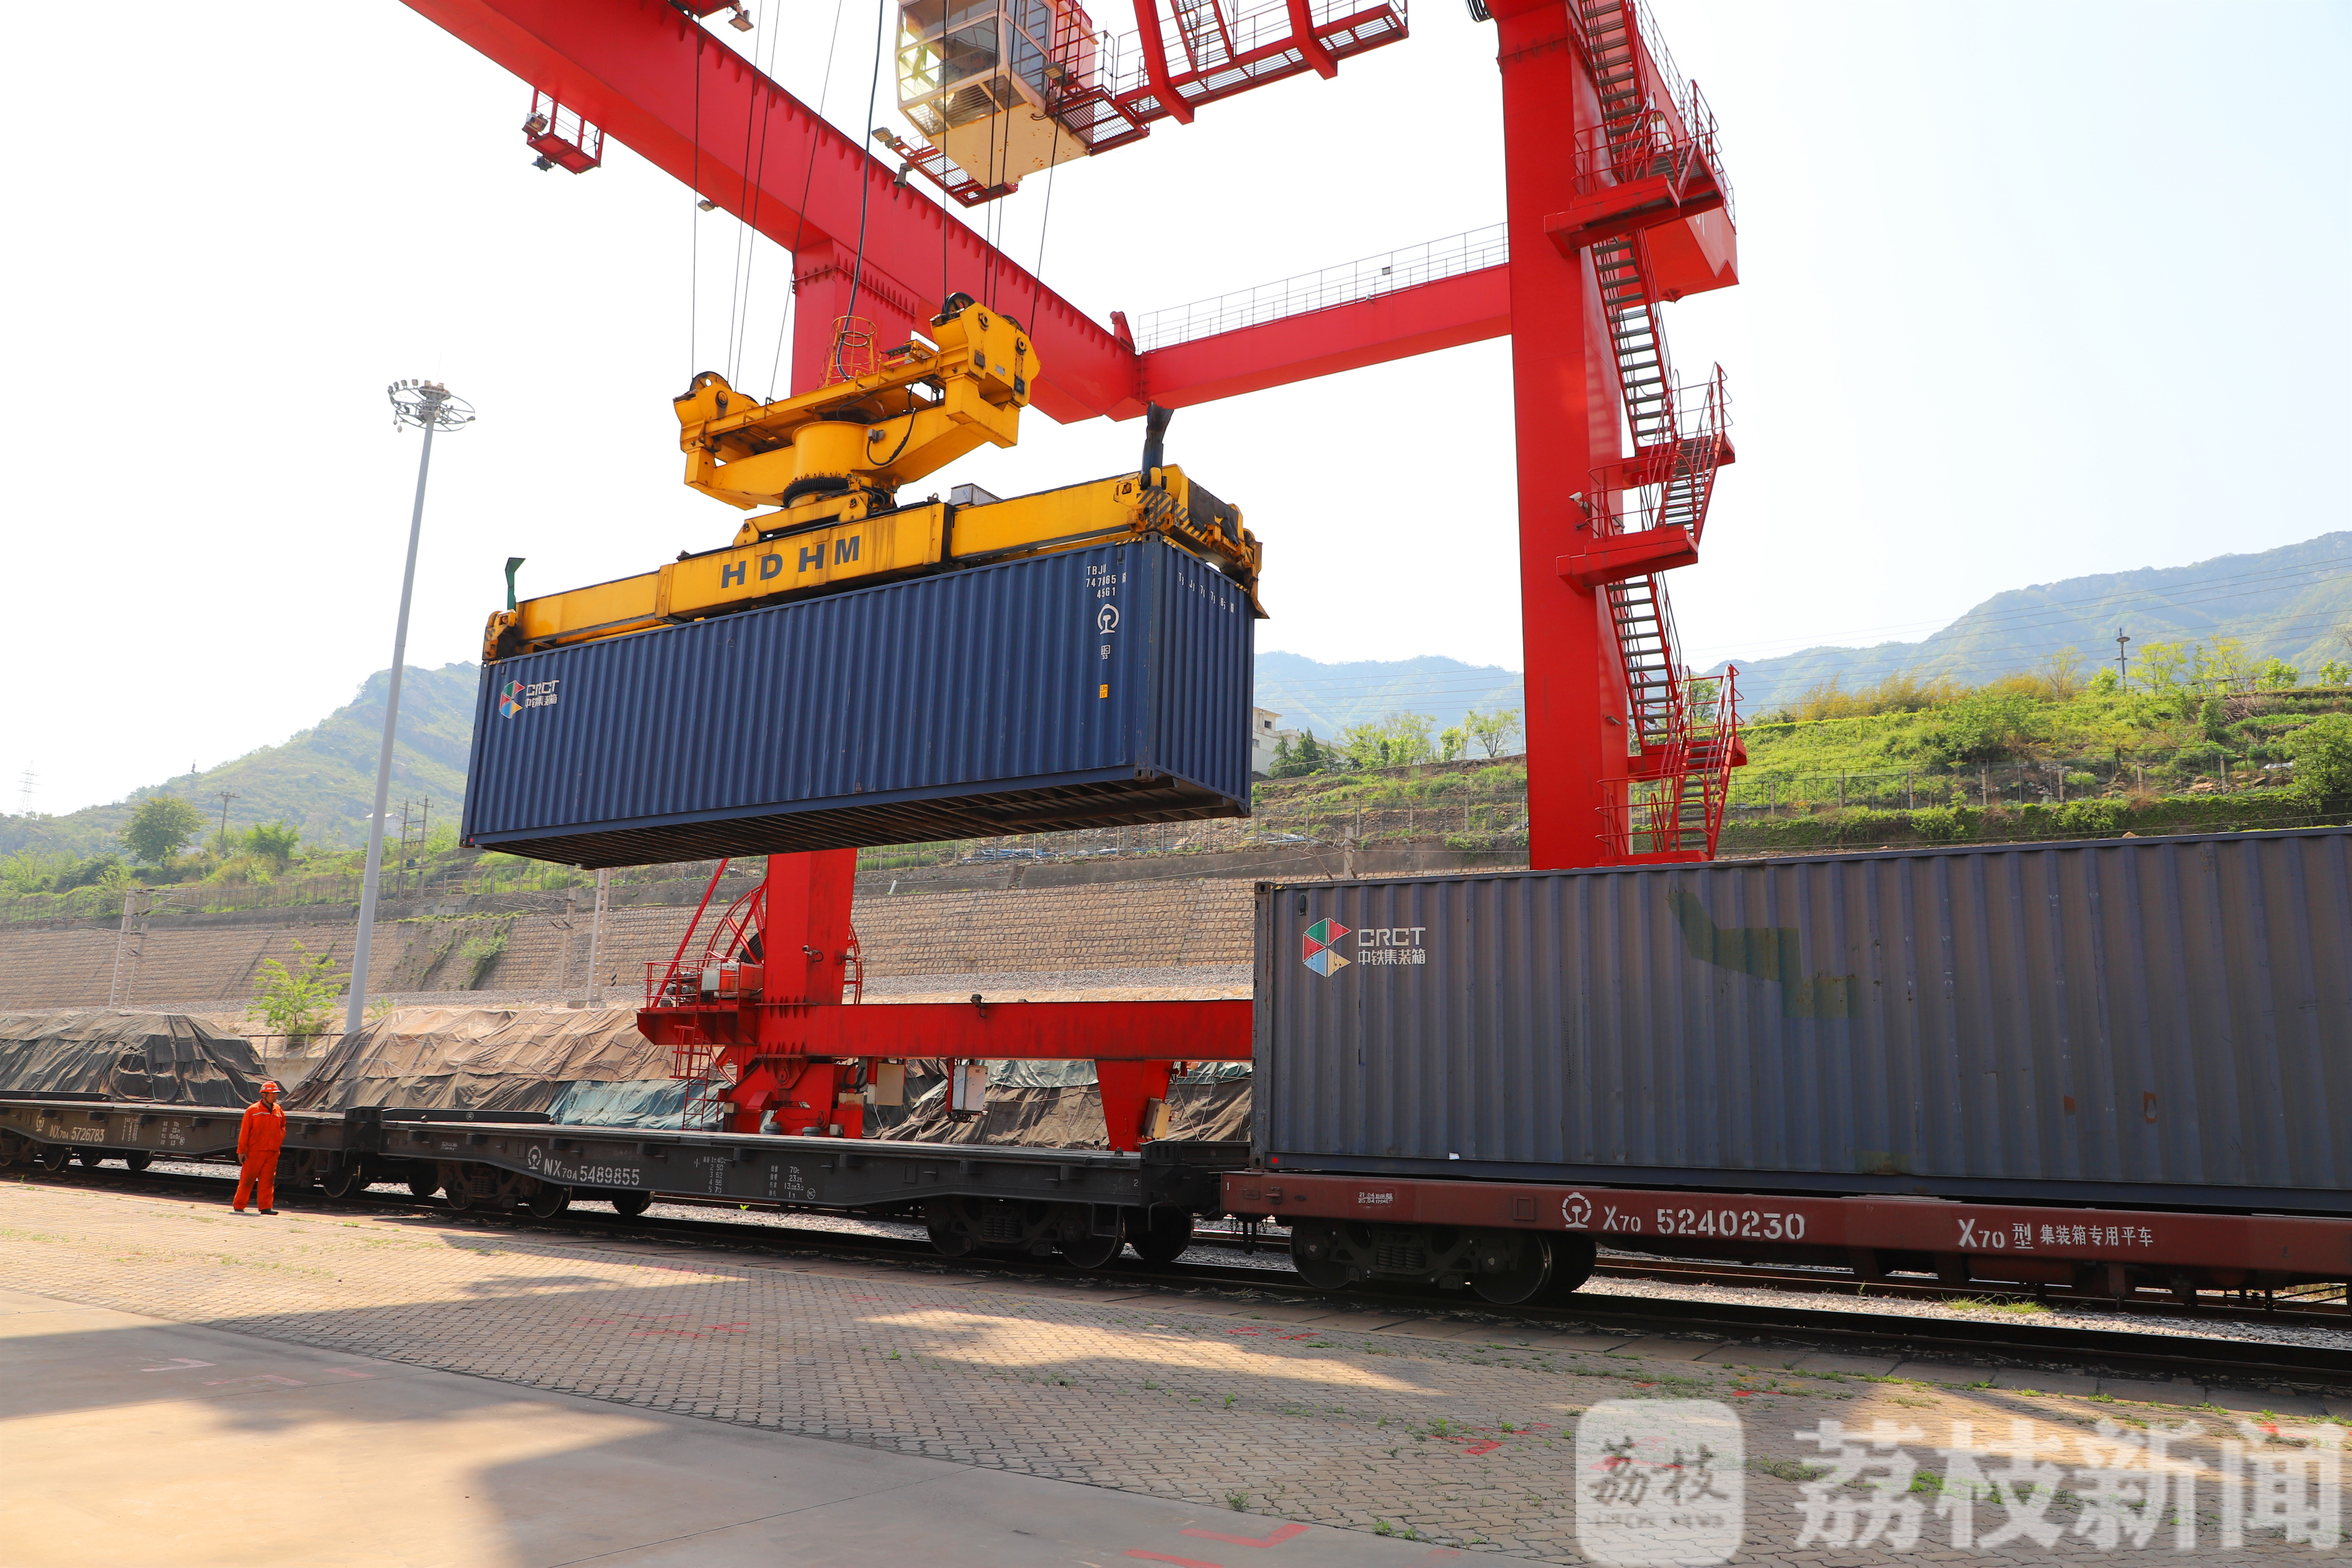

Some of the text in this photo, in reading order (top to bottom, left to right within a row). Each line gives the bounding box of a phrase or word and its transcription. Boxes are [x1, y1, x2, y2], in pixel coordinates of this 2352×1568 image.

[721, 535, 860, 589] HDHM
[1087, 564, 1106, 575] TBJU
[1086, 572, 1126, 588] 747865 6
[1097, 587, 1115, 599] 45G1
[526, 680, 560, 696] CRCT
[525, 693, 558, 708] 中铁集装箱
[1358, 927, 1426, 947] CRCT
[1358, 948, 1426, 965] 中铁集装箱
[50, 1124, 105, 1142] NX70A 5726783
[544, 1158, 640, 1186] NX70A 5489855
[1603, 1205, 1805, 1240] X70 5240230
[2040, 1224, 2154, 1247] 集装箱专用平车
